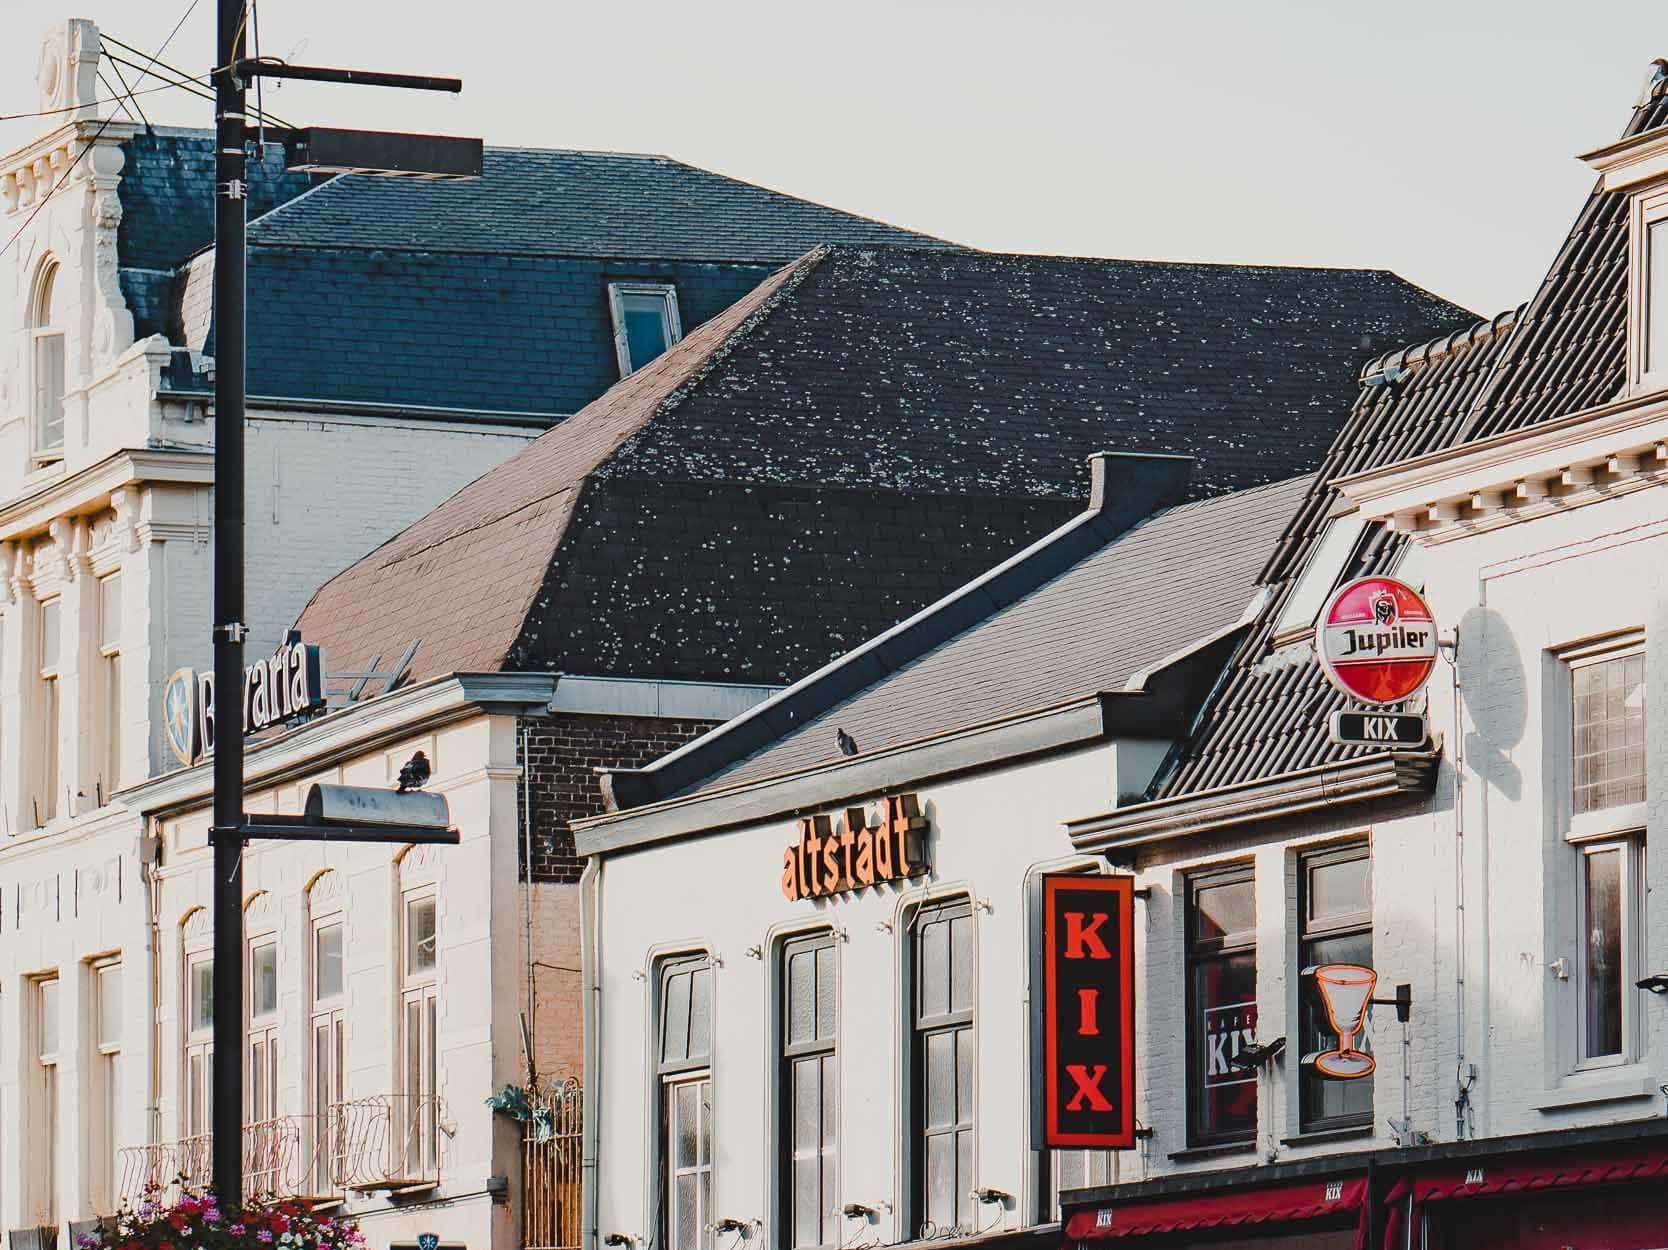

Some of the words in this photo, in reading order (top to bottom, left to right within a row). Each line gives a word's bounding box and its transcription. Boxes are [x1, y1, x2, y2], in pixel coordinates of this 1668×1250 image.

[1340, 626, 1428, 656] Jupiler
[1364, 717, 1399, 740] KIX
[782, 796, 911, 902] altstadt
[1064, 912, 1113, 1111] KIX
[1325, 1187, 1342, 1200] KIX
[1096, 1213, 1112, 1227] KIX
